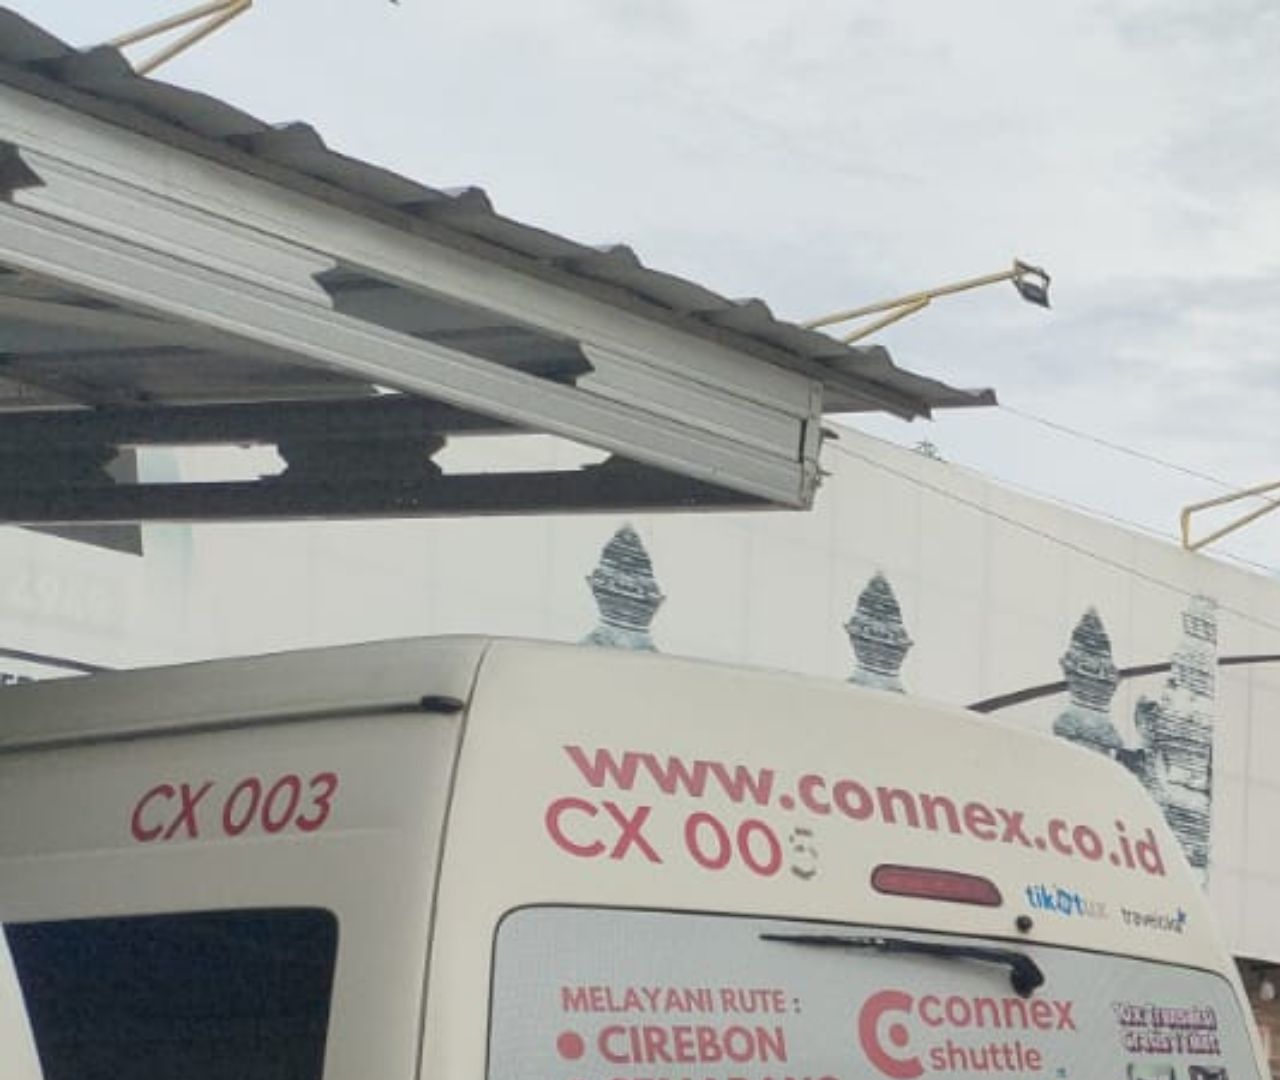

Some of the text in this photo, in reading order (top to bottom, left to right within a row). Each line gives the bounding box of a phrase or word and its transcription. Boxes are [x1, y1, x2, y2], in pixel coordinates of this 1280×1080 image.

[131, 771, 339, 843] CX 003
[563, 745, 1167, 876] www.connex.co.id
[545, 796, 663, 864] CX
[562, 985, 713, 1013] MELAYANI
[720, 988, 785, 1014] RUTE
[917, 994, 1076, 1032] connex
[597, 1025, 788, 1064] CIREBON
[930, 1040, 1042, 1071] shuttle
